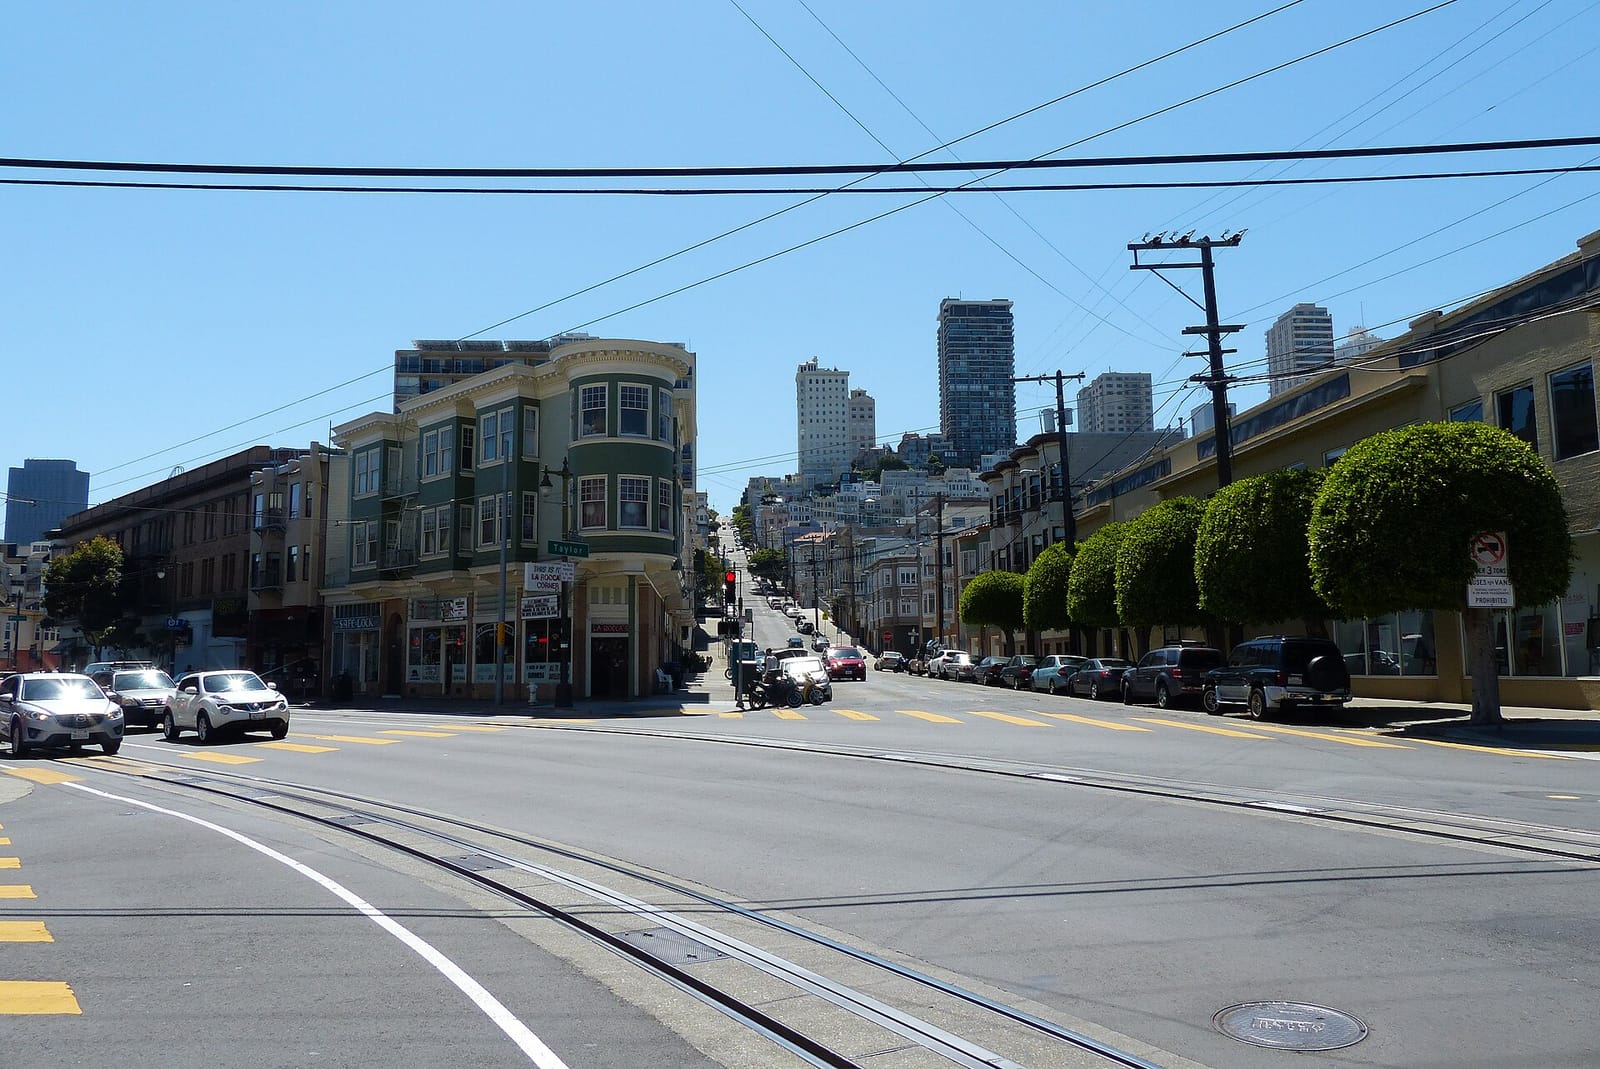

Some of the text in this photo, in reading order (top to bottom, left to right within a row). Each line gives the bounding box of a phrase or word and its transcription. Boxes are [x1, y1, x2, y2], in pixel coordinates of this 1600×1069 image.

[553, 543, 583, 555] Taylor
[533, 565, 546, 573] THIS
[1486, 565, 1492, 575] 3
[536, 581, 560, 590] CORNER
